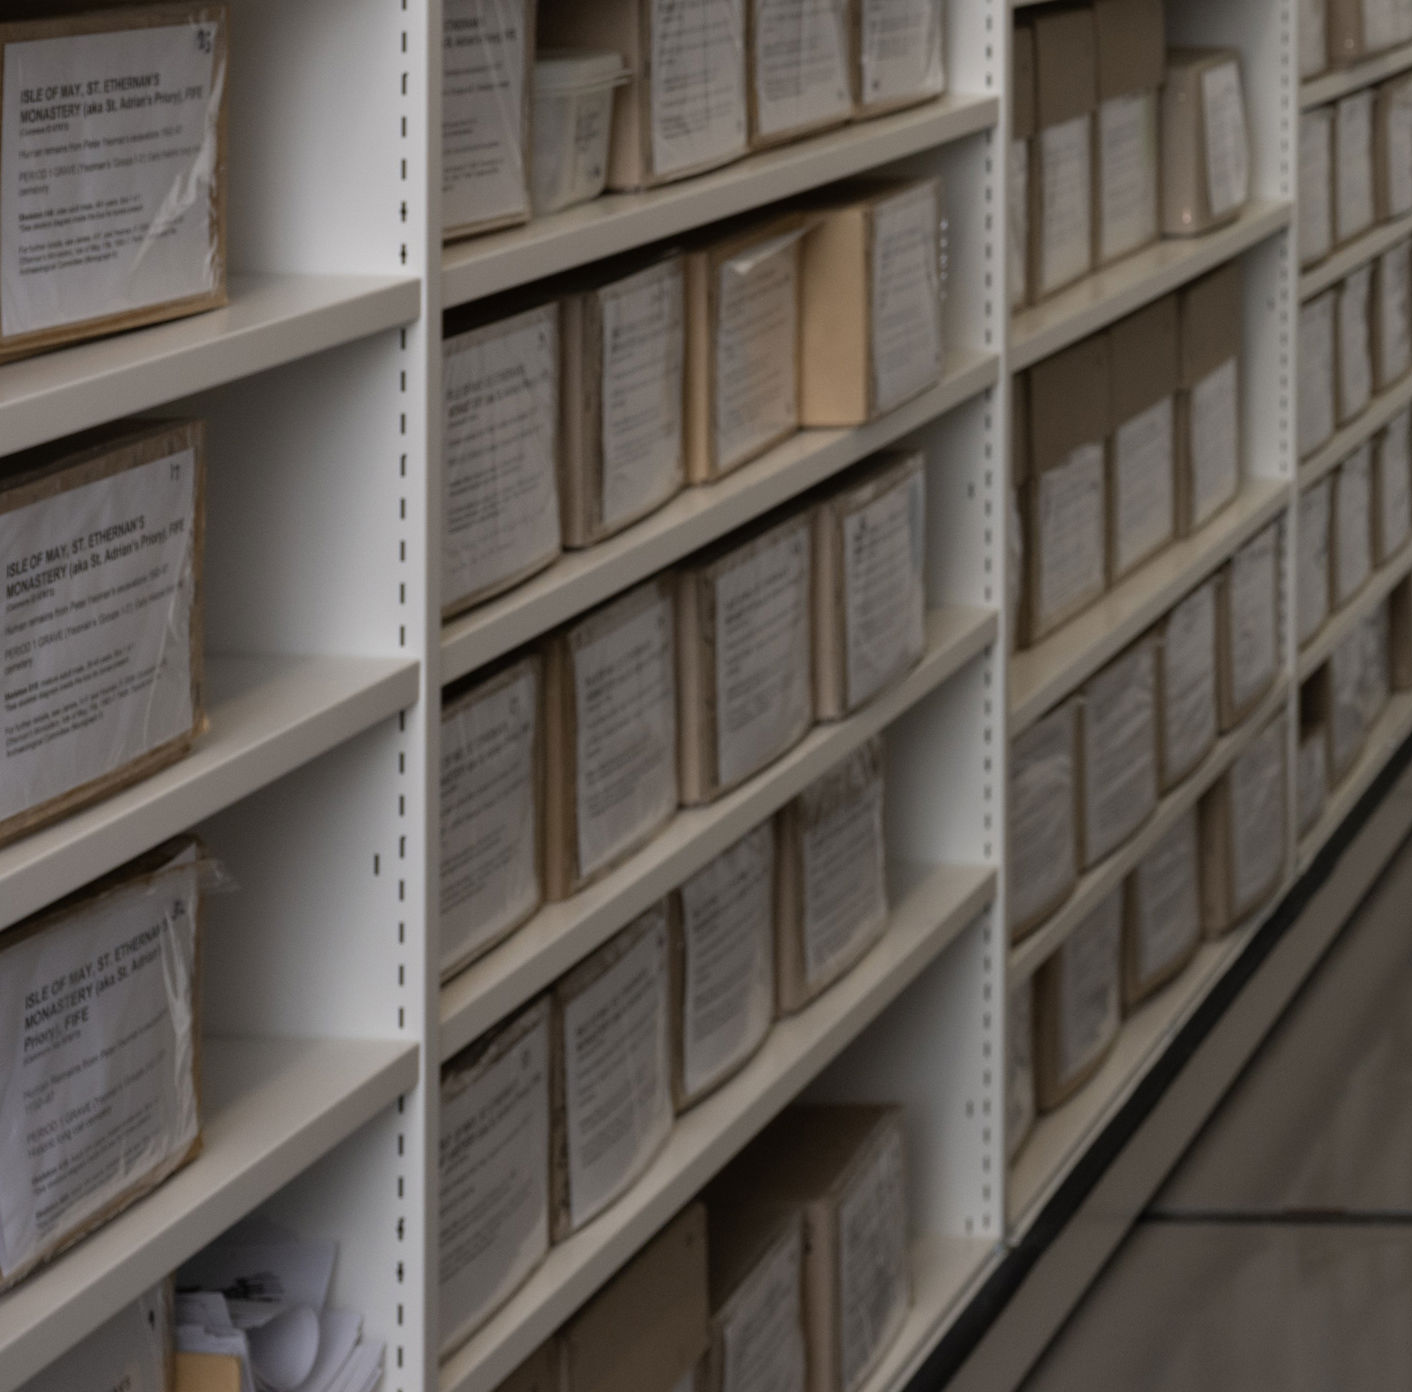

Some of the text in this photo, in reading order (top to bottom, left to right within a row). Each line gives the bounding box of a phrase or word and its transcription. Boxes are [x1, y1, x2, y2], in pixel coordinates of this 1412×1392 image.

[20, 87, 43, 105] ISLE
[45, 85, 60, 101] OF
[86, 80, 101, 97] ST.
[20, 102, 81, 124] MONASTERY
[106, 97, 119, 113] St.
[7, 514, 145, 579] ISLE OF MAY, ST. ETHERNAN'S
[6, 569, 66, 599] MONASTERY
[69, 558, 89, 580] (aka
[90, 552, 103, 570] St.
[104, 541, 140, 564] Adrian's
[24, 986, 93, 1033] MONASTERY
[25, 990, 48, 1011] ISLE
[51, 981, 67, 1001] OF
[65, 1005, 90, 1031] FIFE
